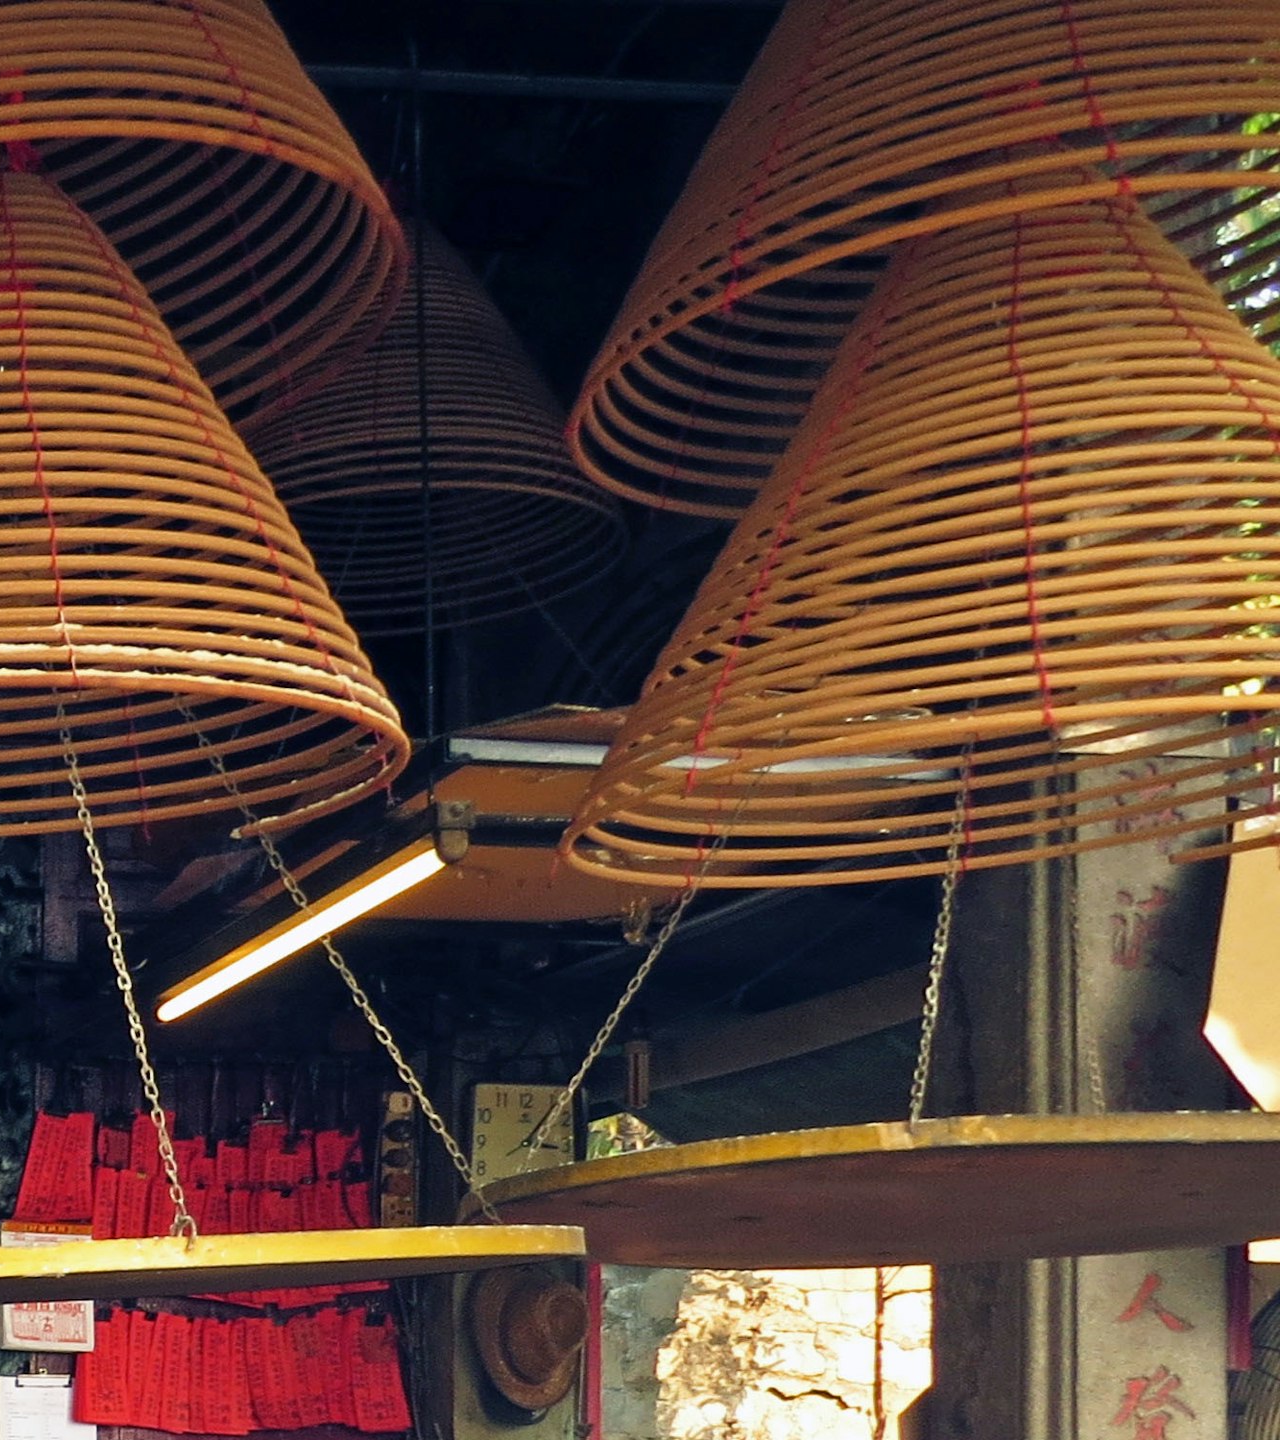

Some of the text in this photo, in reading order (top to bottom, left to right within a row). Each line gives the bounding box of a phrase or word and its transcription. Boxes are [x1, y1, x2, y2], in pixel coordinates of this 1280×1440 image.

[519, 1091, 534, 1108] 12
[477, 1108, 492, 1124] 10
[476, 1134, 486, 1149] 9
[476, 1159, 486, 1175] 8
